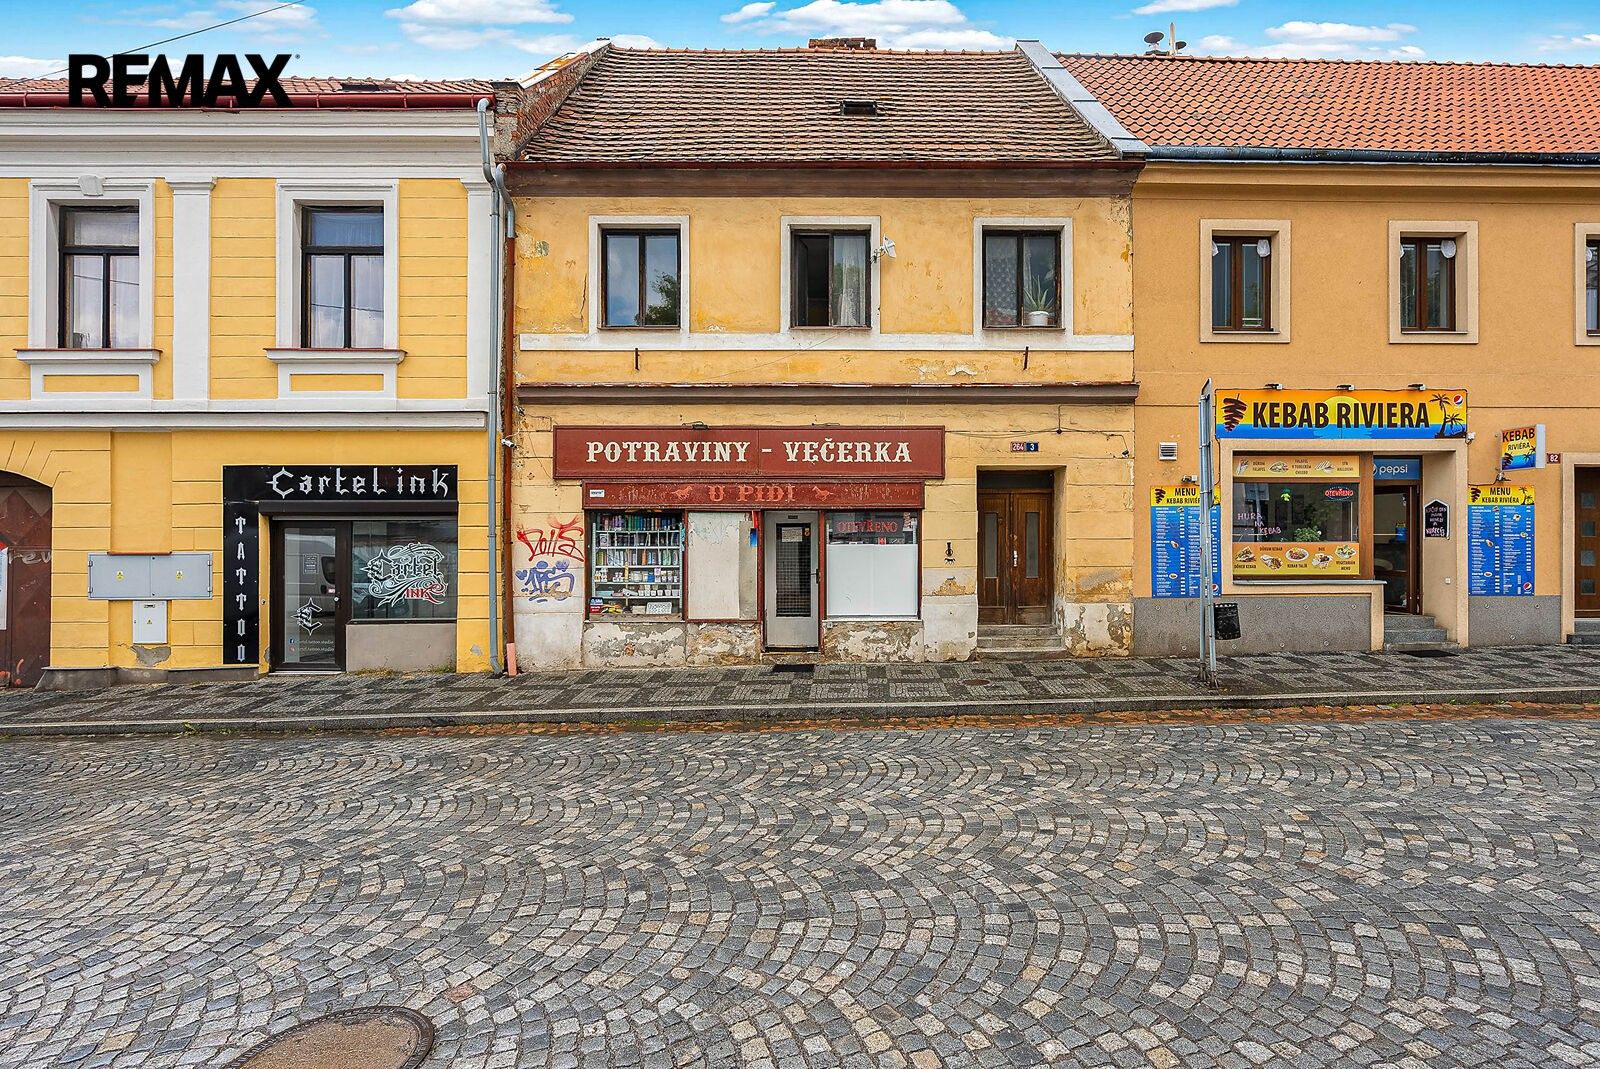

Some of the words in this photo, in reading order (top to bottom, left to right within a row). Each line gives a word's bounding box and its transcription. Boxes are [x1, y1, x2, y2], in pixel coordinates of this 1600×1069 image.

[1253, 402, 1330, 428] KEBAB
[1336, 402, 1430, 428] RIVIERA
[1502, 428, 1535, 442] KEBAB
[586, 441, 750, 463] POTRAVINY
[783, 438, 912, 462] VEČERKA
[1012, 443, 1024, 451] 264
[1030, 443, 1035, 451] 3
[1549, 454, 1559, 462] 82
[1379, 464, 1408, 475] pepsi
[266, 466, 387, 499] Cartel
[397, 467, 449, 497] ink
[708, 485, 726, 502] U
[1174, 487, 1196, 496] MENU
[1489, 487, 1511, 496] MENU
[235, 516, 247, 662] TATTOO
[405, 584, 444, 605] INK
